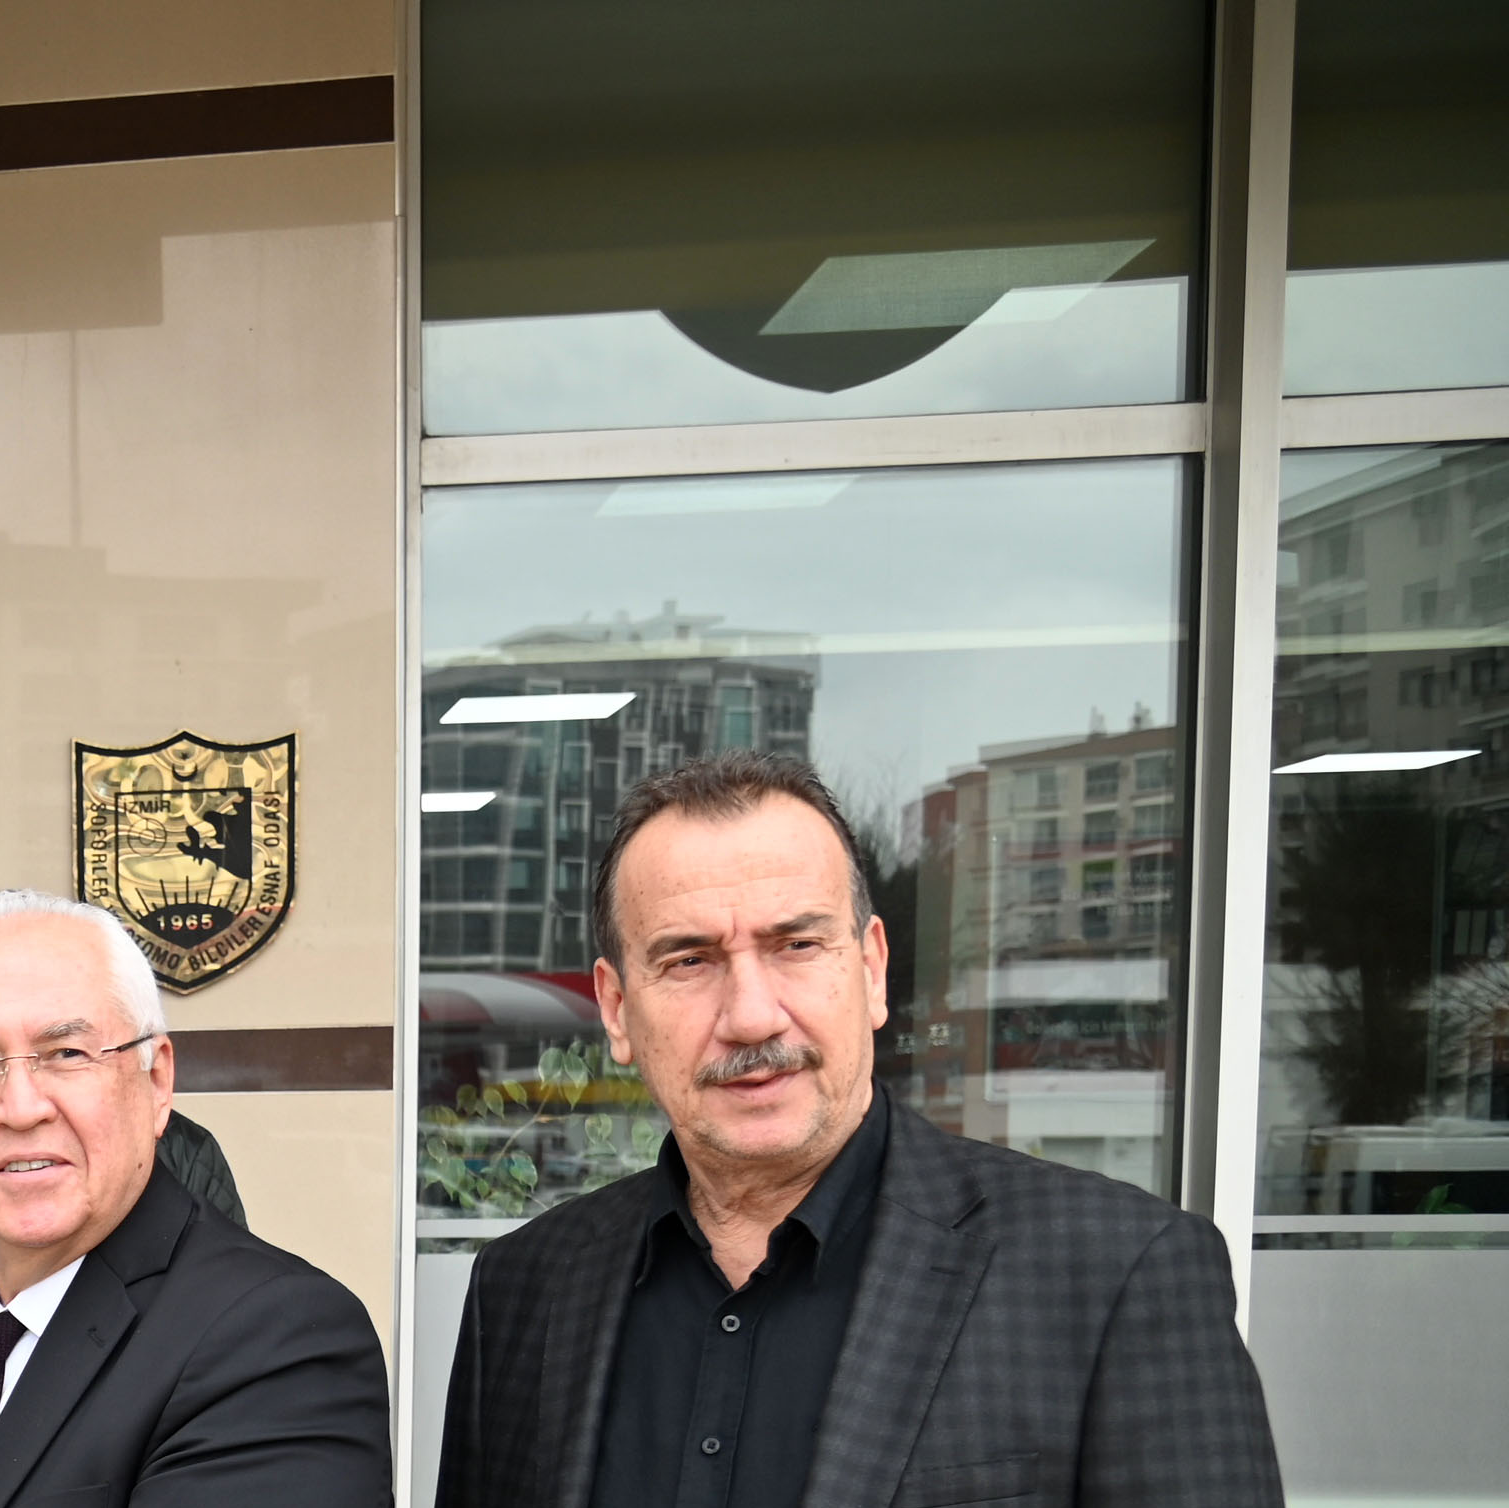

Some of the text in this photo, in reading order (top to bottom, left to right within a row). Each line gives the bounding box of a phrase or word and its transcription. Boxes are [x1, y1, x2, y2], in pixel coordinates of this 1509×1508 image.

[124, 798, 171, 814] İZMİR
[257, 791, 280, 916] ESNAF ODASI
[157, 913, 214, 931] 1965
